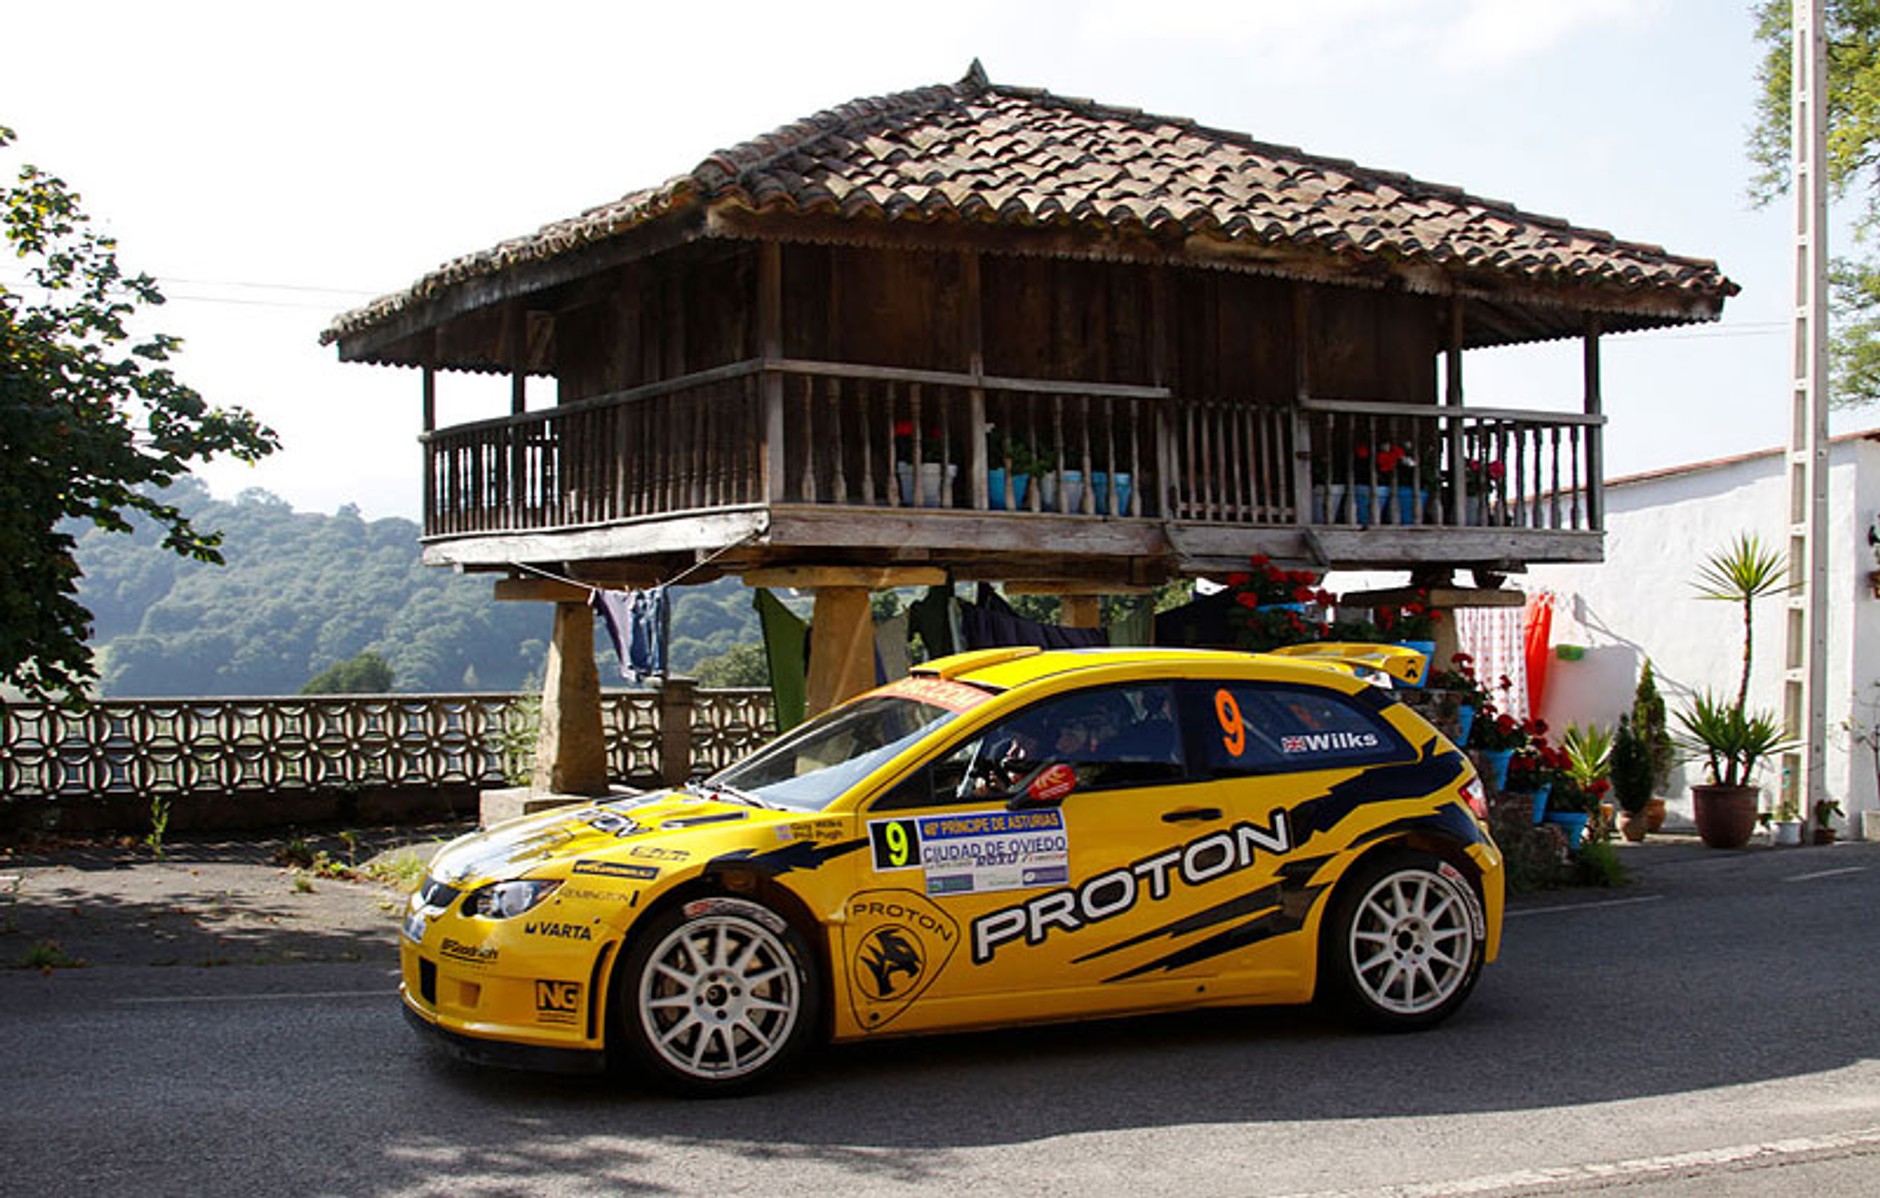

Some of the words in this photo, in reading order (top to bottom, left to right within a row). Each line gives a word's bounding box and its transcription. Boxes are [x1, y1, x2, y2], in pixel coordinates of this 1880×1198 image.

[1213, 687, 1246, 758] 9
[1305, 733, 1379, 751] Wilks
[992, 818, 1006, 831] DE
[1008, 813, 1060, 830] ASTURIAS
[886, 821, 909, 867] 9
[923, 842, 981, 864] CIUDAD
[984, 840, 1004, 856] DE
[1008, 836, 1066, 853] OVIEDO
[975, 810, 1292, 962] PROTON
[539, 922, 592, 941] VARTA
[852, 903, 954, 942] PROTON
[536, 981, 580, 1012] NG
